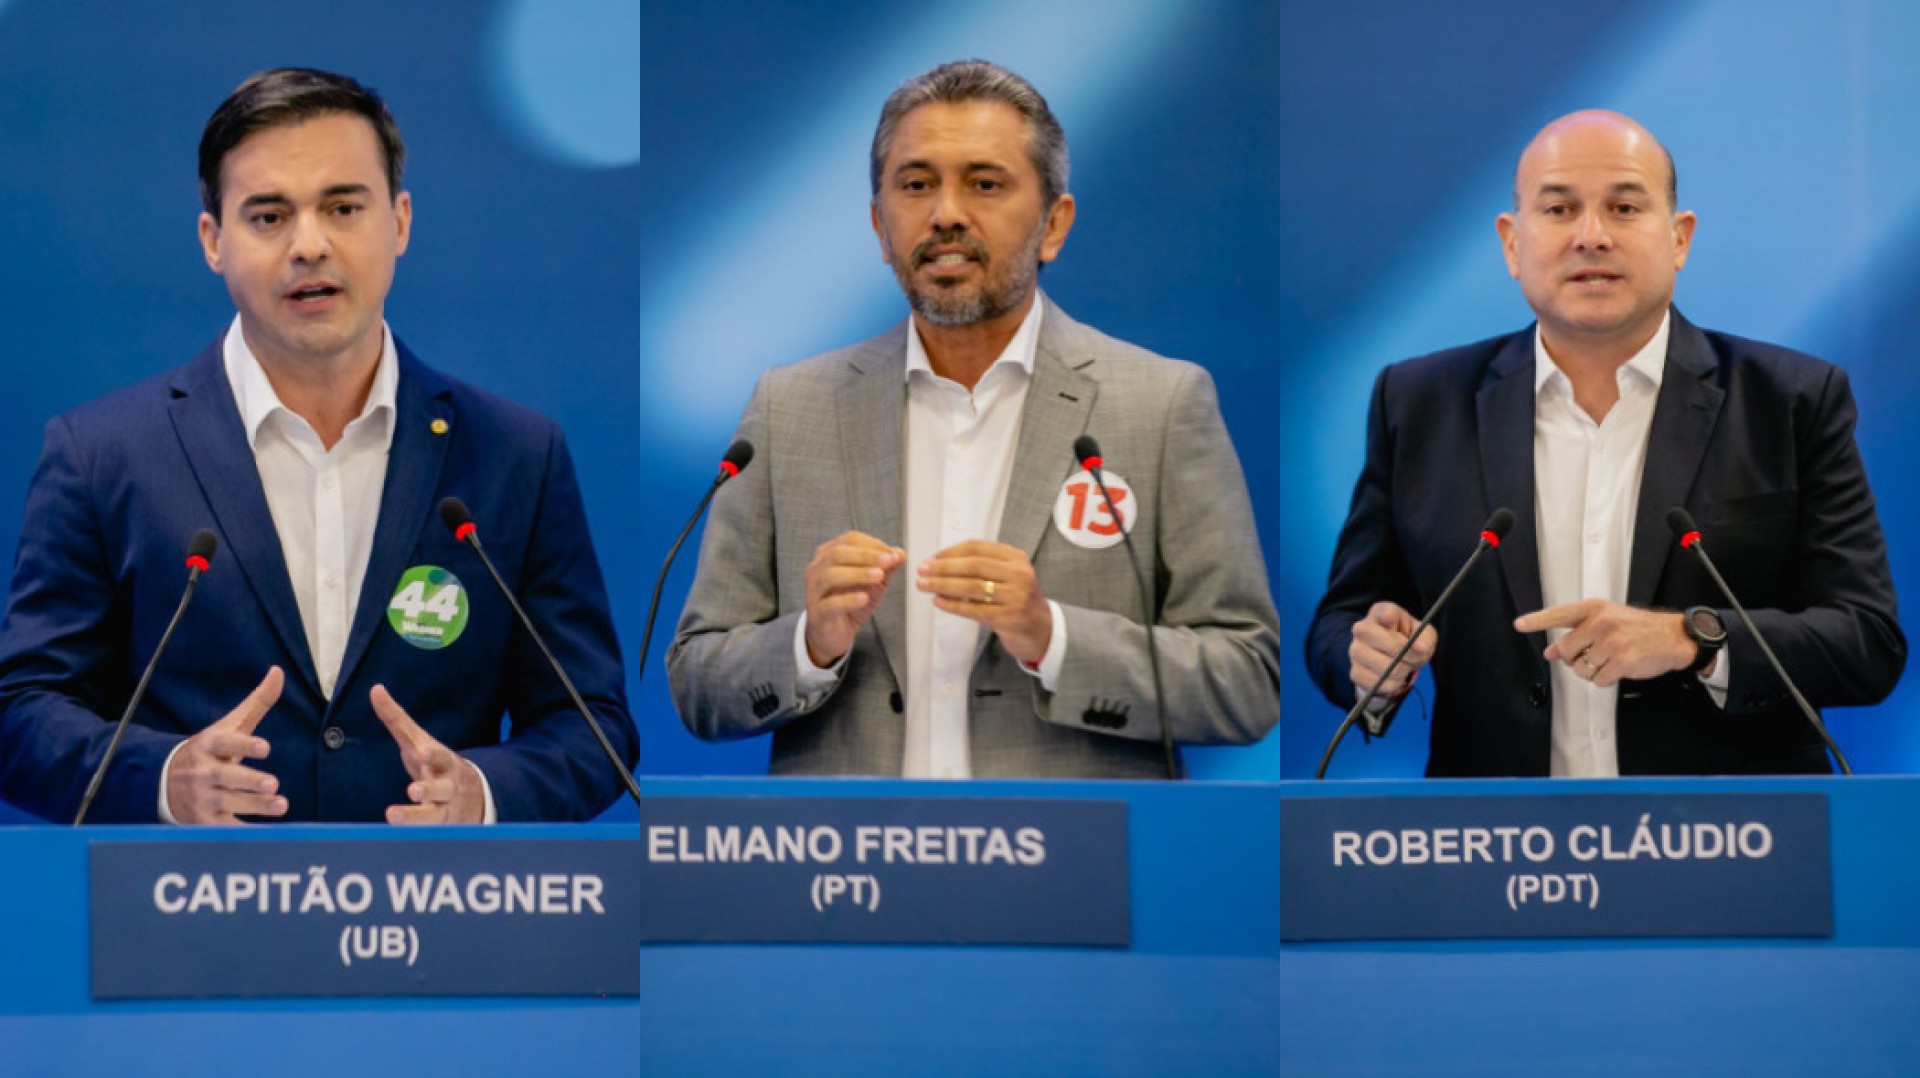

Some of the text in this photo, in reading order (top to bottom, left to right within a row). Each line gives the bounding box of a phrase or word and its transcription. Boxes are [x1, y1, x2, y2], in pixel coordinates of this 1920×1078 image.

[1065, 482, 1128, 535] 13
[390, 581, 459, 622] 44
[648, 825, 1046, 866] ELMANO FREITAS
[1332, 813, 1773, 866] ROBERTO CLÁUDIO
[153, 866, 605, 914] CAPITÃO WAGNER
[811, 874, 880, 912] (PT)
[1506, 873, 1600, 910] (PDT)
[339, 925, 420, 967] (UB)
